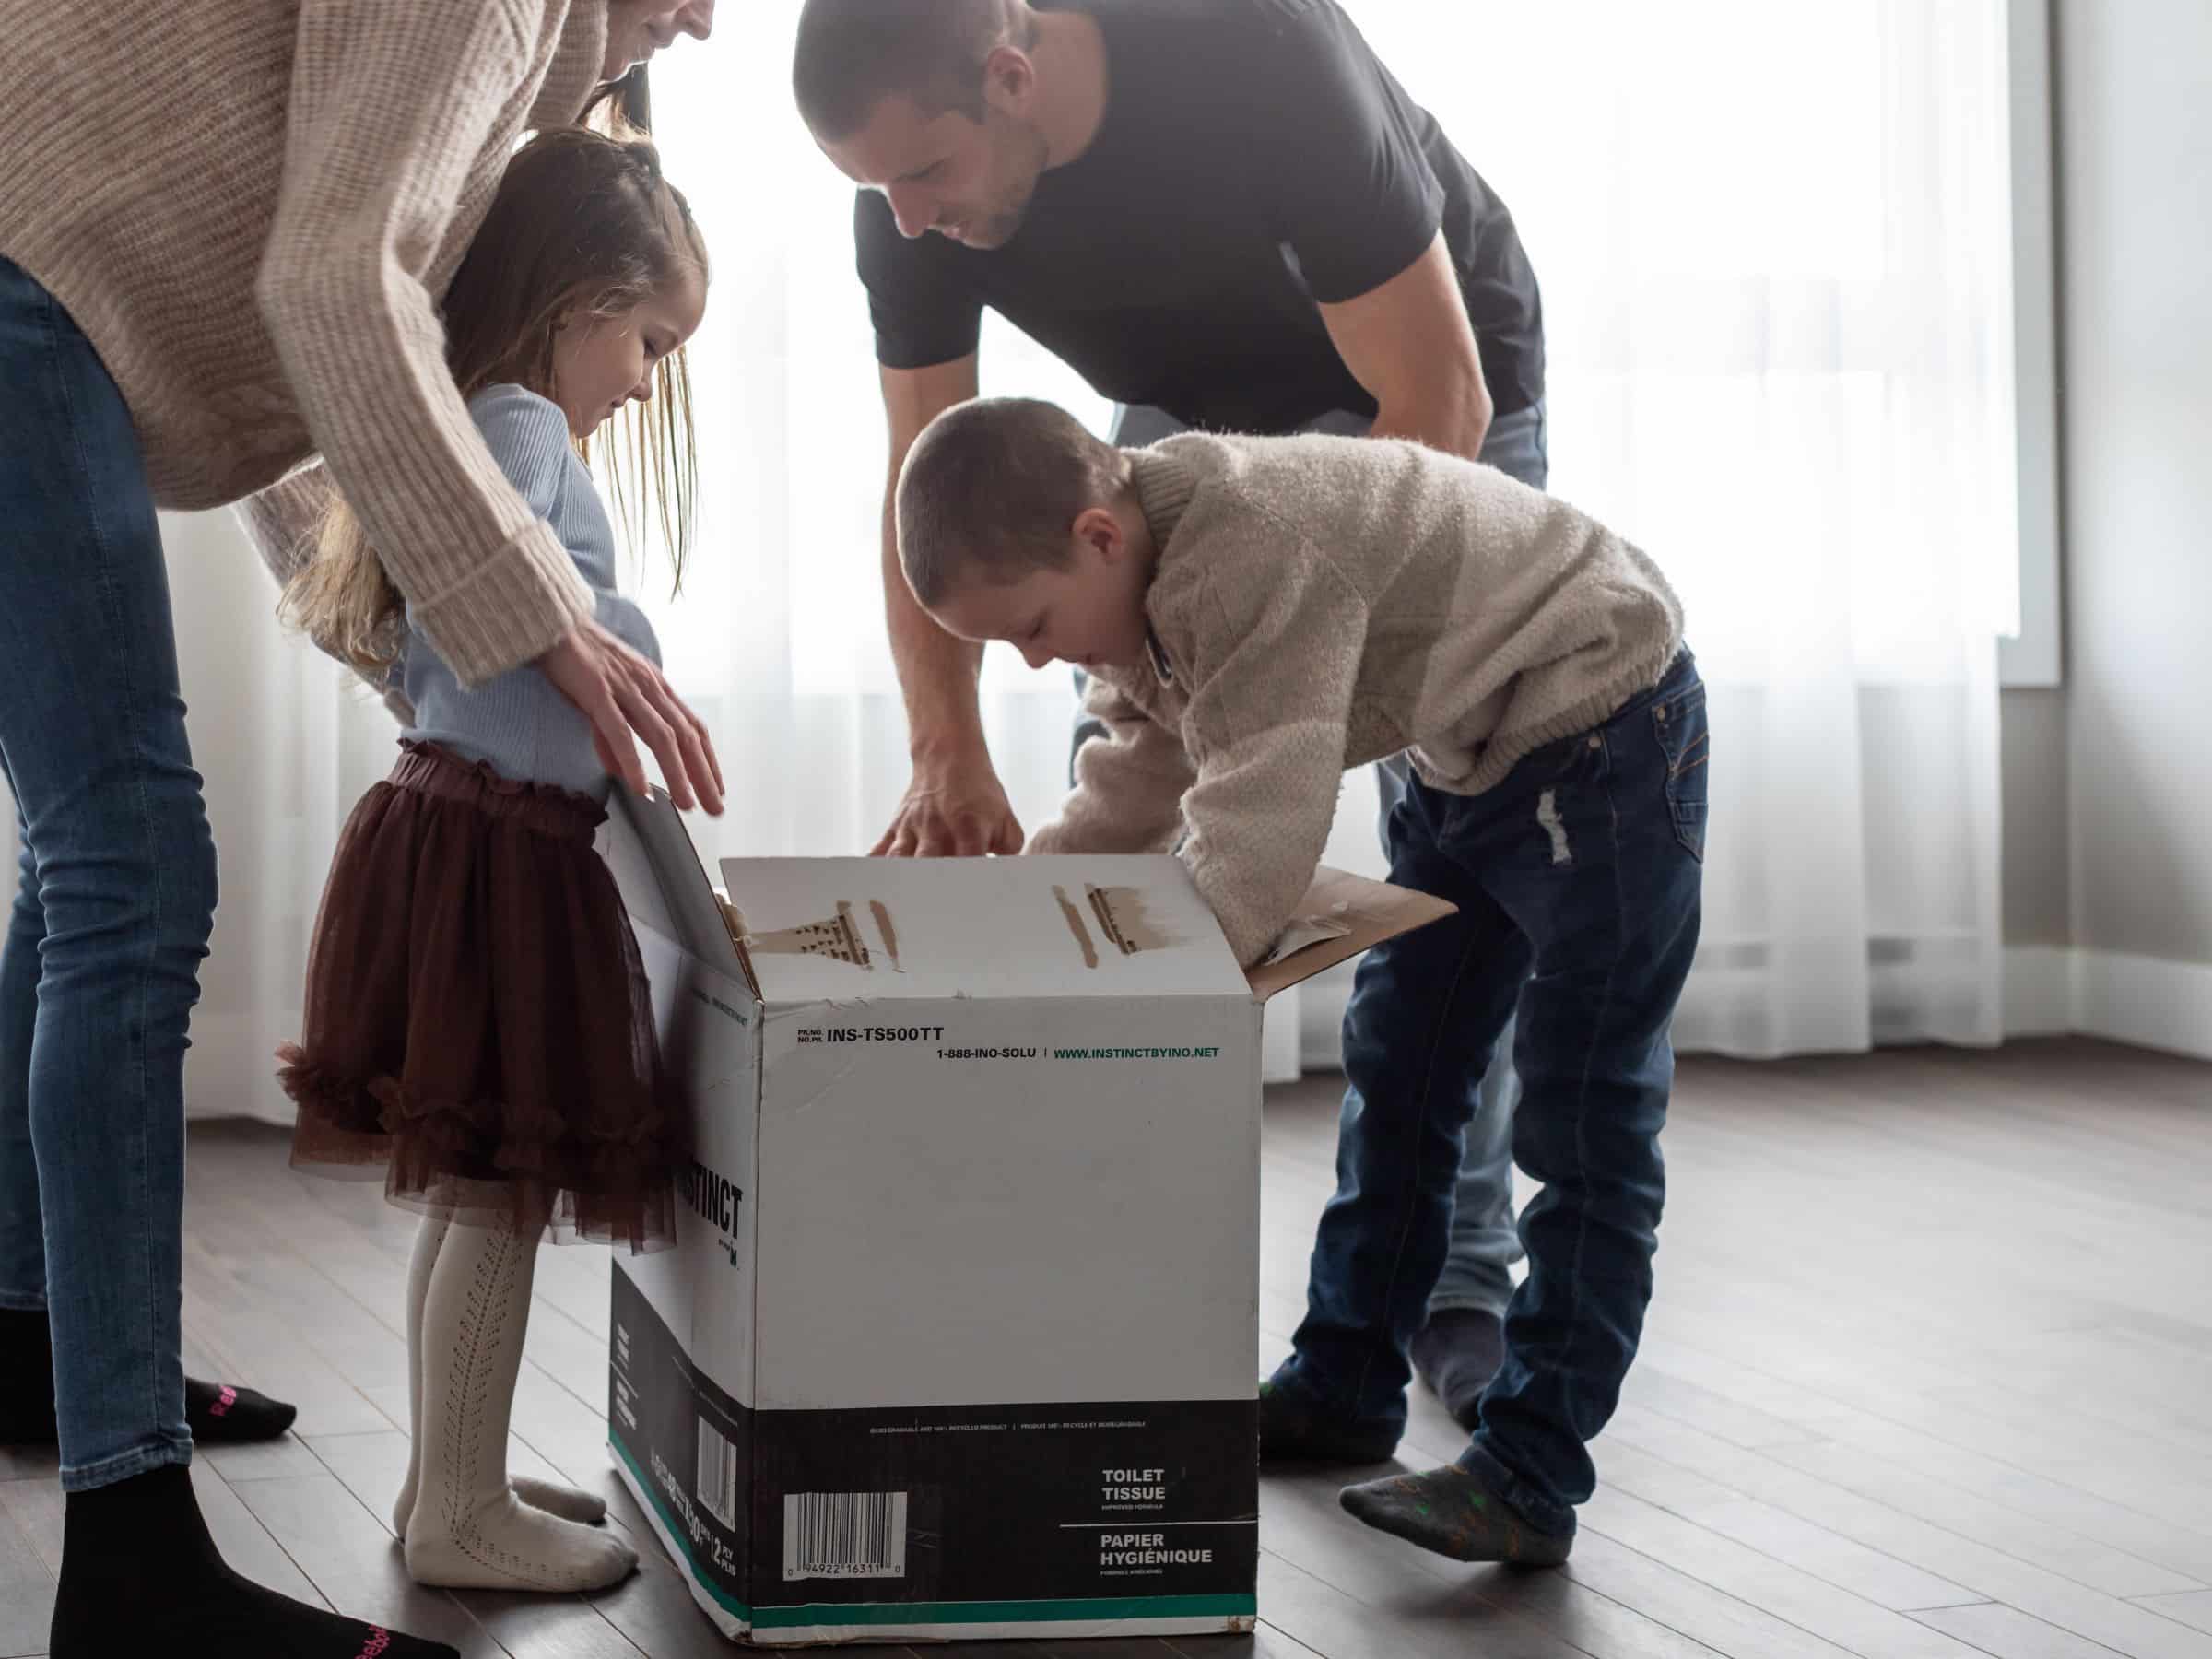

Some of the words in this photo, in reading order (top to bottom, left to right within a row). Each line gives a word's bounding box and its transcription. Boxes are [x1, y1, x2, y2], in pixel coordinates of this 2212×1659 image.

[828, 1027, 944, 1042] INS-TS500TT
[936, 1047, 1037, 1059] 1-888-INO-SOLU
[1053, 1047, 1220, 1059] WWW.INSTINCTBYINO.NET
[1102, 1468, 1165, 1483] TOILET
[1101, 1486, 1166, 1500] TISSUE
[1100, 1533, 1165, 1548] PAPIER
[1100, 1548, 1213, 1566] HYGIÉNIQUE
[805, 1563, 841, 1574] 94922
[847, 1562, 880, 1574] 16311
